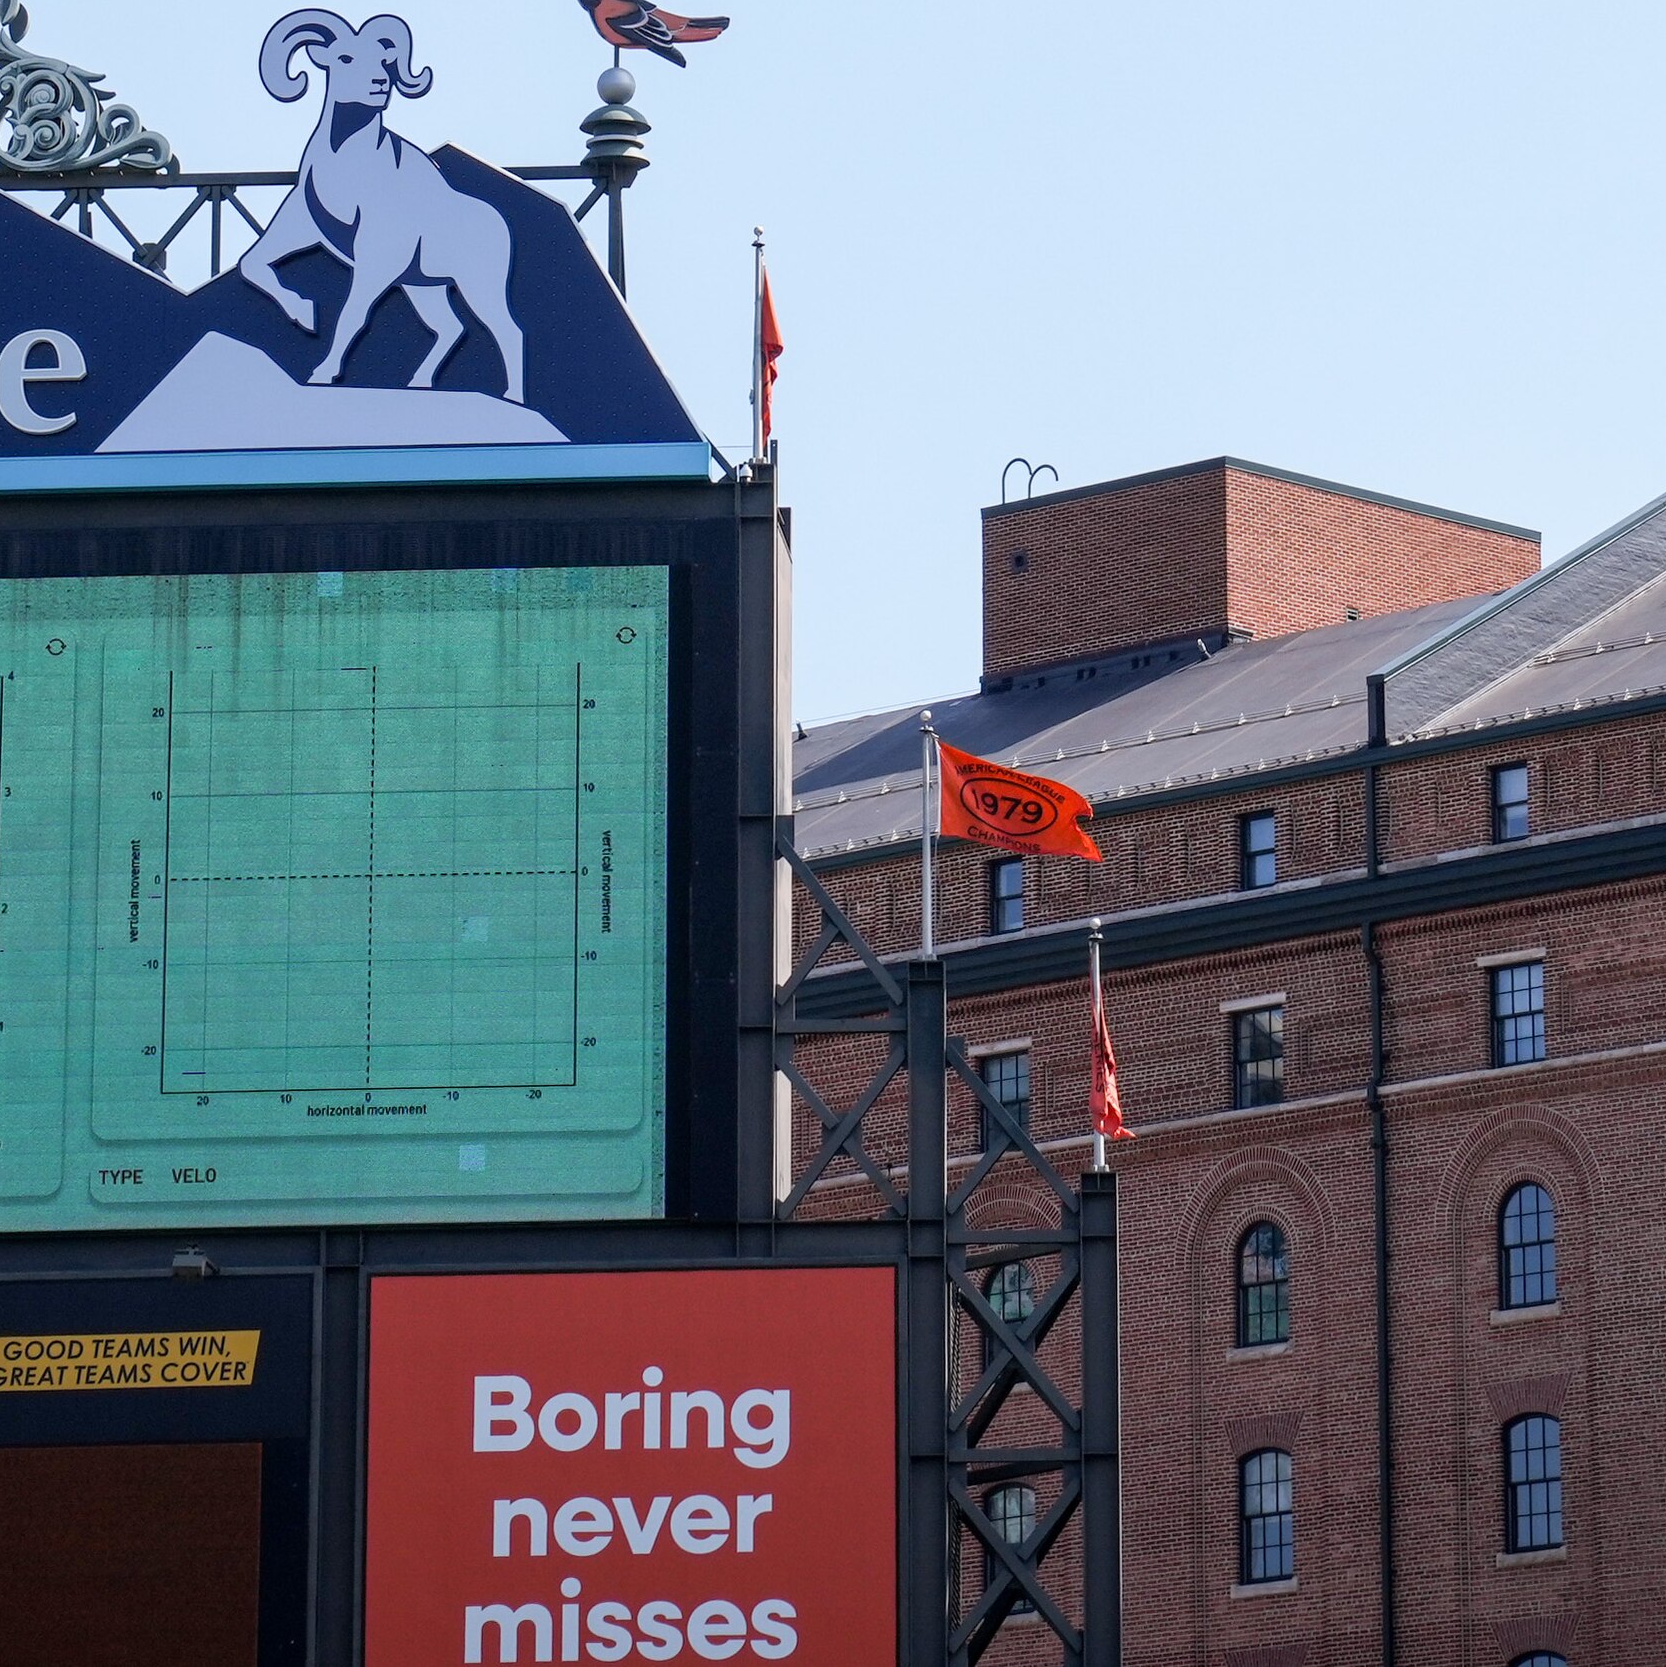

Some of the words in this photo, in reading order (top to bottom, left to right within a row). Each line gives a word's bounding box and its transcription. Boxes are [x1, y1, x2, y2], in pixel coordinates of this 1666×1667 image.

[583, 699, 596, 709] 20
[152, 708, 165, 718] 20
[4, 787, 11, 797] 3
[583, 782, 595, 792] 10
[151, 791, 163, 801] 10
[971, 789, 1043, 824] 1979
[967, 825, 1041, 852] CHAMPIONS
[602, 830, 613, 872] vertical
[130, 839, 140, 899] movement
[1, 904, 8, 914] 2
[602, 874, 613, 934] movement
[128, 901, 139, 943] vertical
[581, 951, 597, 961] -10
[142, 960, 159, 970] -10
[581, 1037, 597, 1047] -20
[141, 1045, 157, 1056] -20
[280, 1094, 292, 1104] 10
[443, 1091, 460, 1101] -10
[525, 1089, 542, 1100] -20
[196, 1095, 209, 1106] 20
[307, 1105, 365, 1117] horizontal
[367, 1104, 427, 1116] movement
[99, 1169, 144, 1184] TYPE
[172, 1168, 217, 1183] VELO
[3, 1340, 84, 1361] GOOD
[92, 1337, 170, 1358] TEAMS
[179, 1336, 231, 1358] WIN,
[75, 1363, 153, 1385] TEAMS
[161, 1361, 247, 1382] COVER
[473, 1366, 791, 1469] Boring
[492, 1493, 773, 1558] never
[464, 1578, 798, 1664] misses
